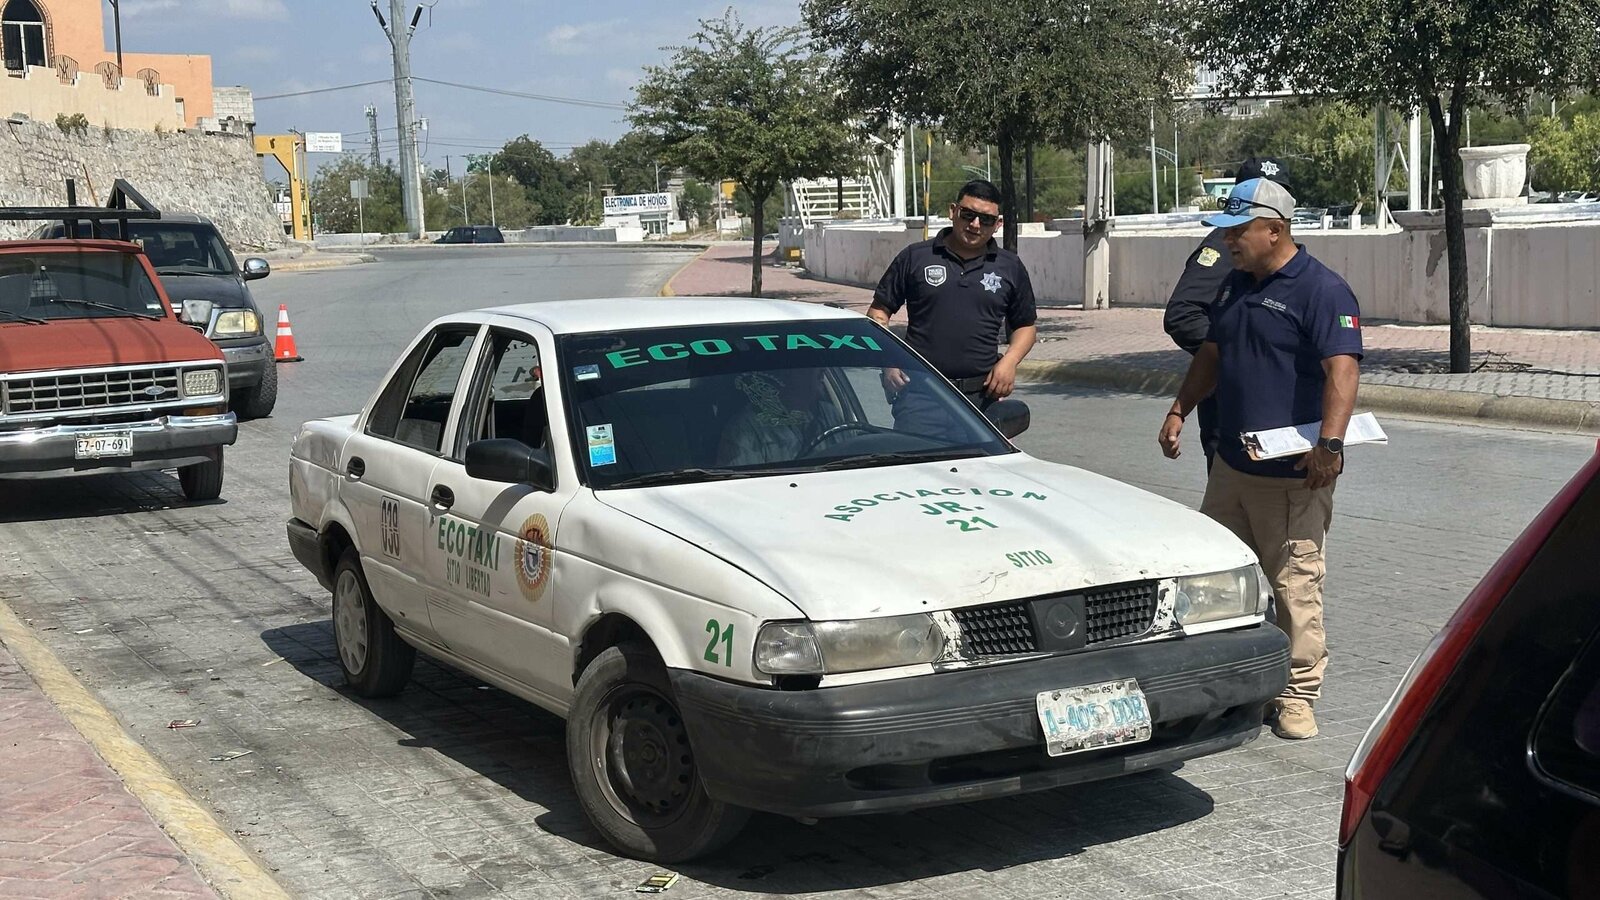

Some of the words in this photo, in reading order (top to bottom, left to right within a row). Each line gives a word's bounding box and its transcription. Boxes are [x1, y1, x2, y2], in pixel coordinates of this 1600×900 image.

[605, 196, 637, 208] ELECTRONICA
[639, 196, 646, 206] DE
[605, 339, 732, 369] ECO
[743, 334, 883, 351] TAXI
[78, 438, 129, 453] EZ-07-691
[823, 487, 1048, 522] ASOCIACION
[919, 501, 985, 516] JR.
[946, 516, 999, 532] 21
[438, 516, 501, 571] ECOTAXI
[1005, 549, 1053, 568] SITIO
[446, 557, 461, 585] SITIO
[465, 565, 491, 598] LIBERTAD
[704, 618, 734, 668] 21
